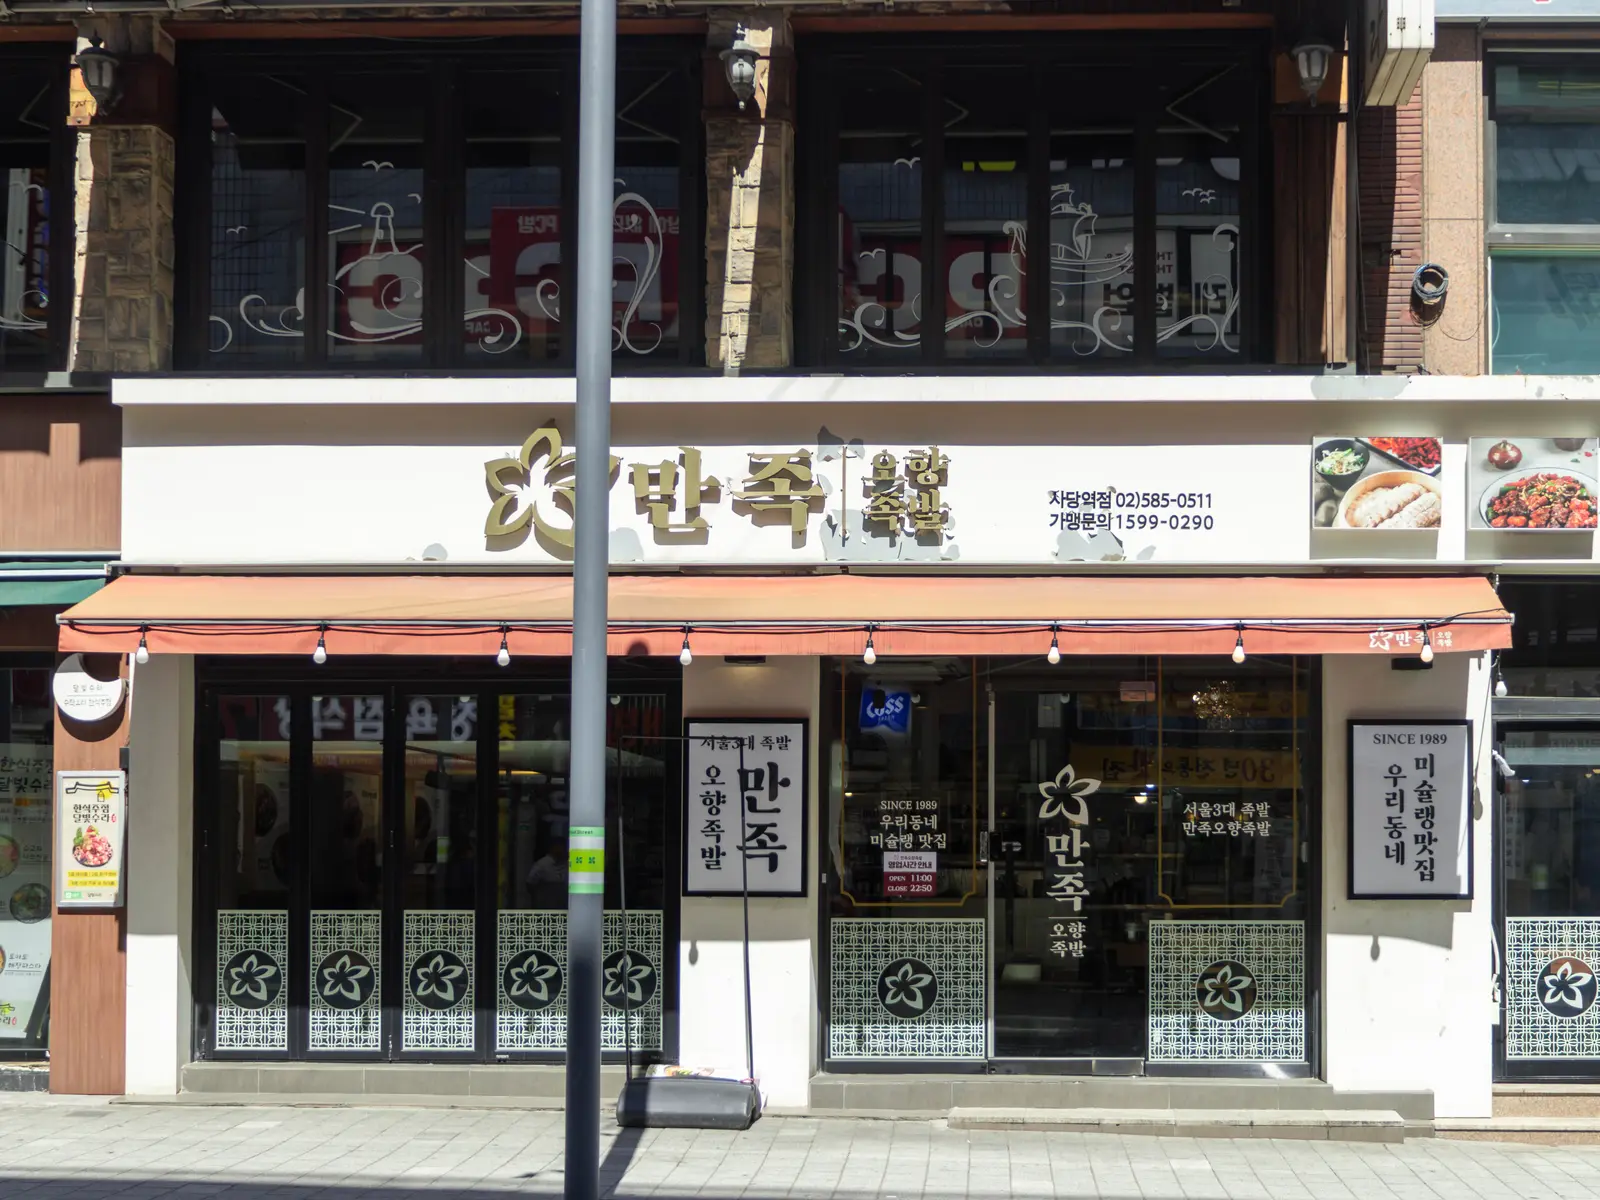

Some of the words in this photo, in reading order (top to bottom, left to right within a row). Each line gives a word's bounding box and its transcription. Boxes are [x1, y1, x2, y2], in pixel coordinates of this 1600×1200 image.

[861, 444, 951, 486] 오향
[628, 446, 828, 536] 만족
[1116, 492, 1212, 510] 02)585-0511
[861, 489, 951, 532] 족발
[1049, 511, 1112, 531] 가맹문의
[1116, 514, 1214, 531] 1599-0290
[700, 735, 755, 751] 서울3대
[760, 735, 791, 750] 족발
[1373, 733, 1416, 745] SINCE
[1419, 733, 1447, 745] 1989
[880, 800, 912, 810] SINCE
[915, 800, 937, 810] 1989
[1183, 801, 1235, 819] 서울3대
[1240, 801, 1271, 818] 족발
[1383, 763, 1407, 865] 우리동네
[699, 765, 726, 870] 오향족발
[736, 761, 791, 873] 만족
[879, 814, 938, 831] 우리동네
[1413, 753, 1438, 882] 미슐랭맛집
[1182, 820, 1272, 837] 만족오향족발
[870, 832, 913, 849] 미슐랭
[918, 832, 946, 849] 맛집
[888, 861, 917, 869] 영업시간
[917, 861, 932, 869] 안내
[1045, 827, 1091, 913] 만족
[910, 874, 932, 882] 11:00
[910, 884, 932, 892] 22:50
[1049, 921, 1087, 940] 오향
[1049, 940, 1087, 958] 족발
